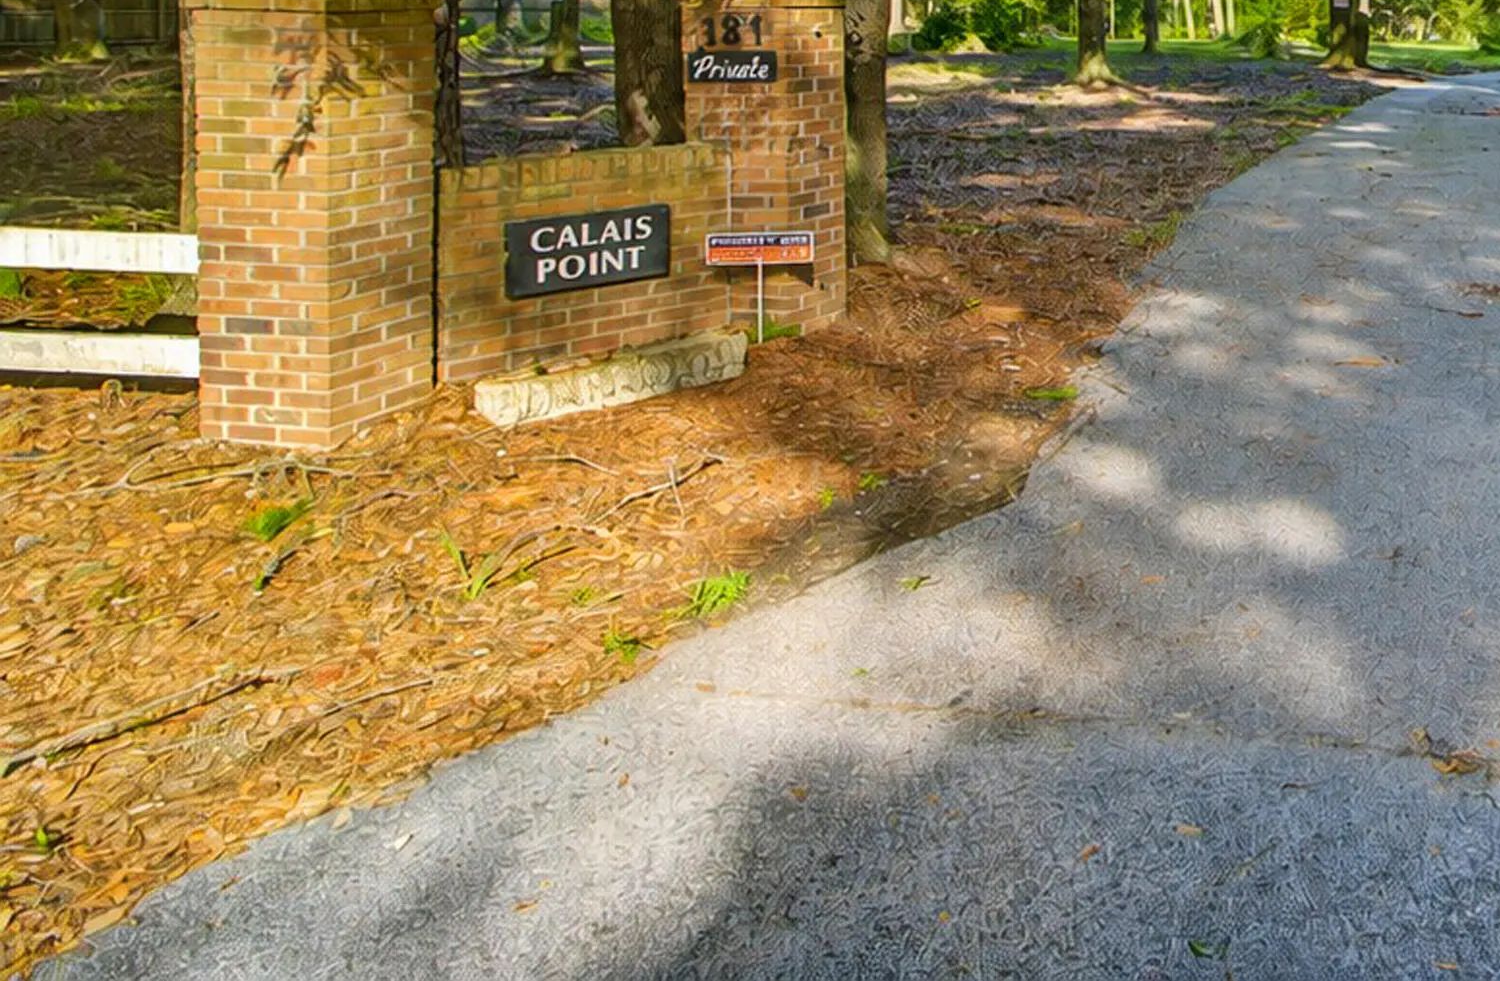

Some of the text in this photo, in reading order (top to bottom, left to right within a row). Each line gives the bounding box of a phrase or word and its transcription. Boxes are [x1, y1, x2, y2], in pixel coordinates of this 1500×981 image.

[702, 14, 762, 46] 181
[693, 54, 769, 79] Private
[530, 215, 652, 253] CALAIS
[536, 245, 646, 284] POINT
